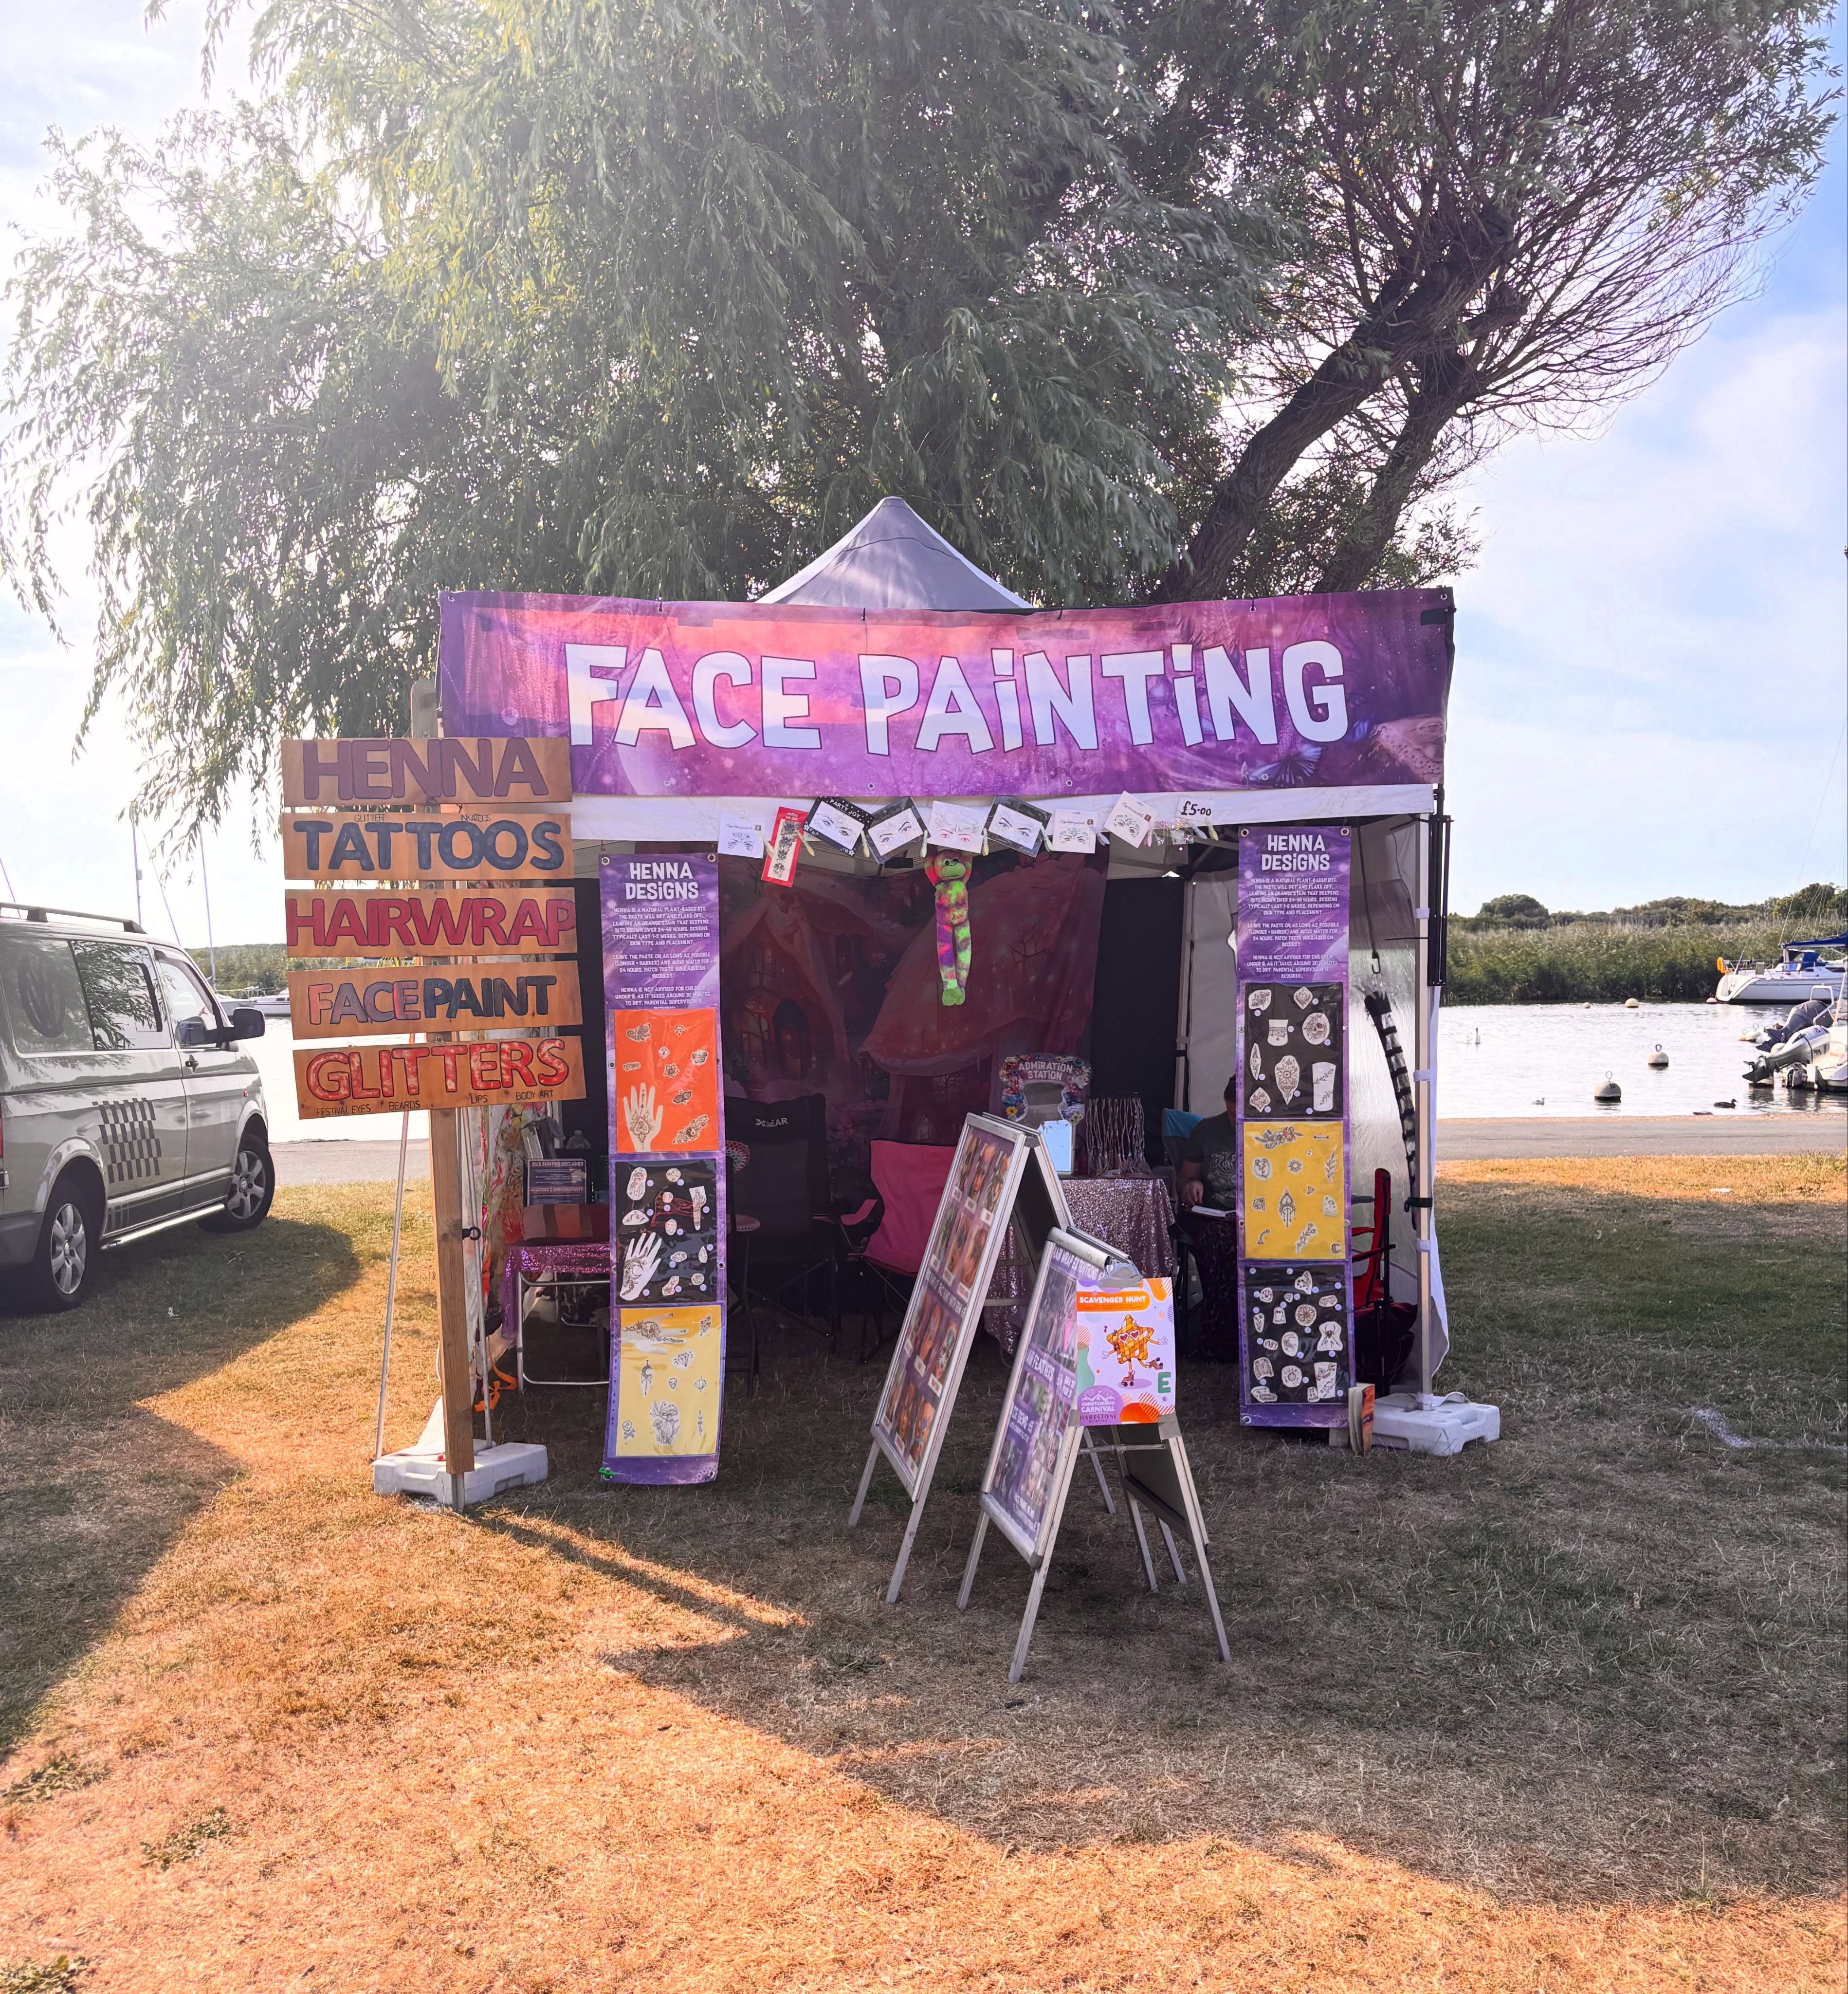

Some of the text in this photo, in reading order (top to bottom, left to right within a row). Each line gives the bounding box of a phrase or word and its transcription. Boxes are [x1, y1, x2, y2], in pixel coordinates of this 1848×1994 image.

[562, 642, 822, 751] FACE
[303, 737, 549, 800] HENNA
[829, 799, 849, 811] PARTY
[293, 820, 564, 870] TATTOOS
[1267, 834, 1325, 851] HENNA
[629, 862, 693, 880] HENNA
[286, 898, 576, 947] HAIRWRAP
[307, 1039, 569, 1101] GLITTERS
[470, 1095, 488, 1104] LIPS
[515, 1091, 536, 1100] BODY
[316, 1100, 421, 1116] FESTIVAL EYES BEARDS
[1061, 1250, 1074, 1267] WRAP
[1157, 1371, 1171, 1393] E
